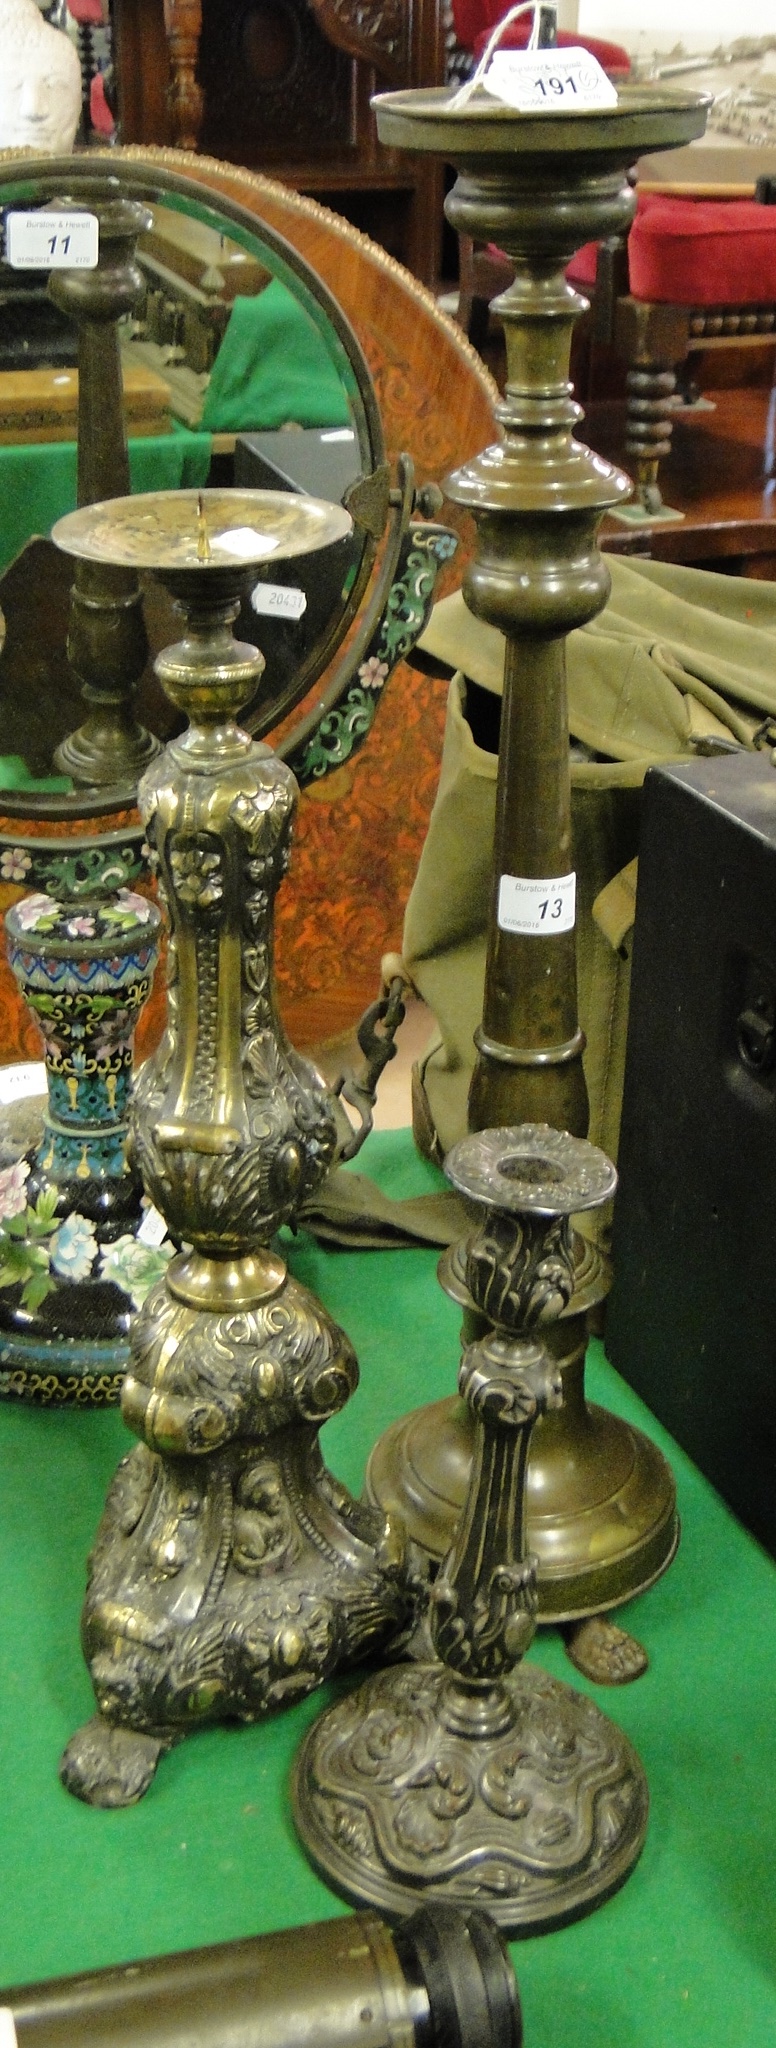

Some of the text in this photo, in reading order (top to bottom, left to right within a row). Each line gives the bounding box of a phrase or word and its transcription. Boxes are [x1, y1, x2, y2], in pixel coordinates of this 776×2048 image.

[534, 76, 578, 96] 191
[47, 234, 71, 255] 11
[515, 882, 549, 893] Burstow
[550, 884, 556, 892] &
[538, 898, 563, 920] 13
